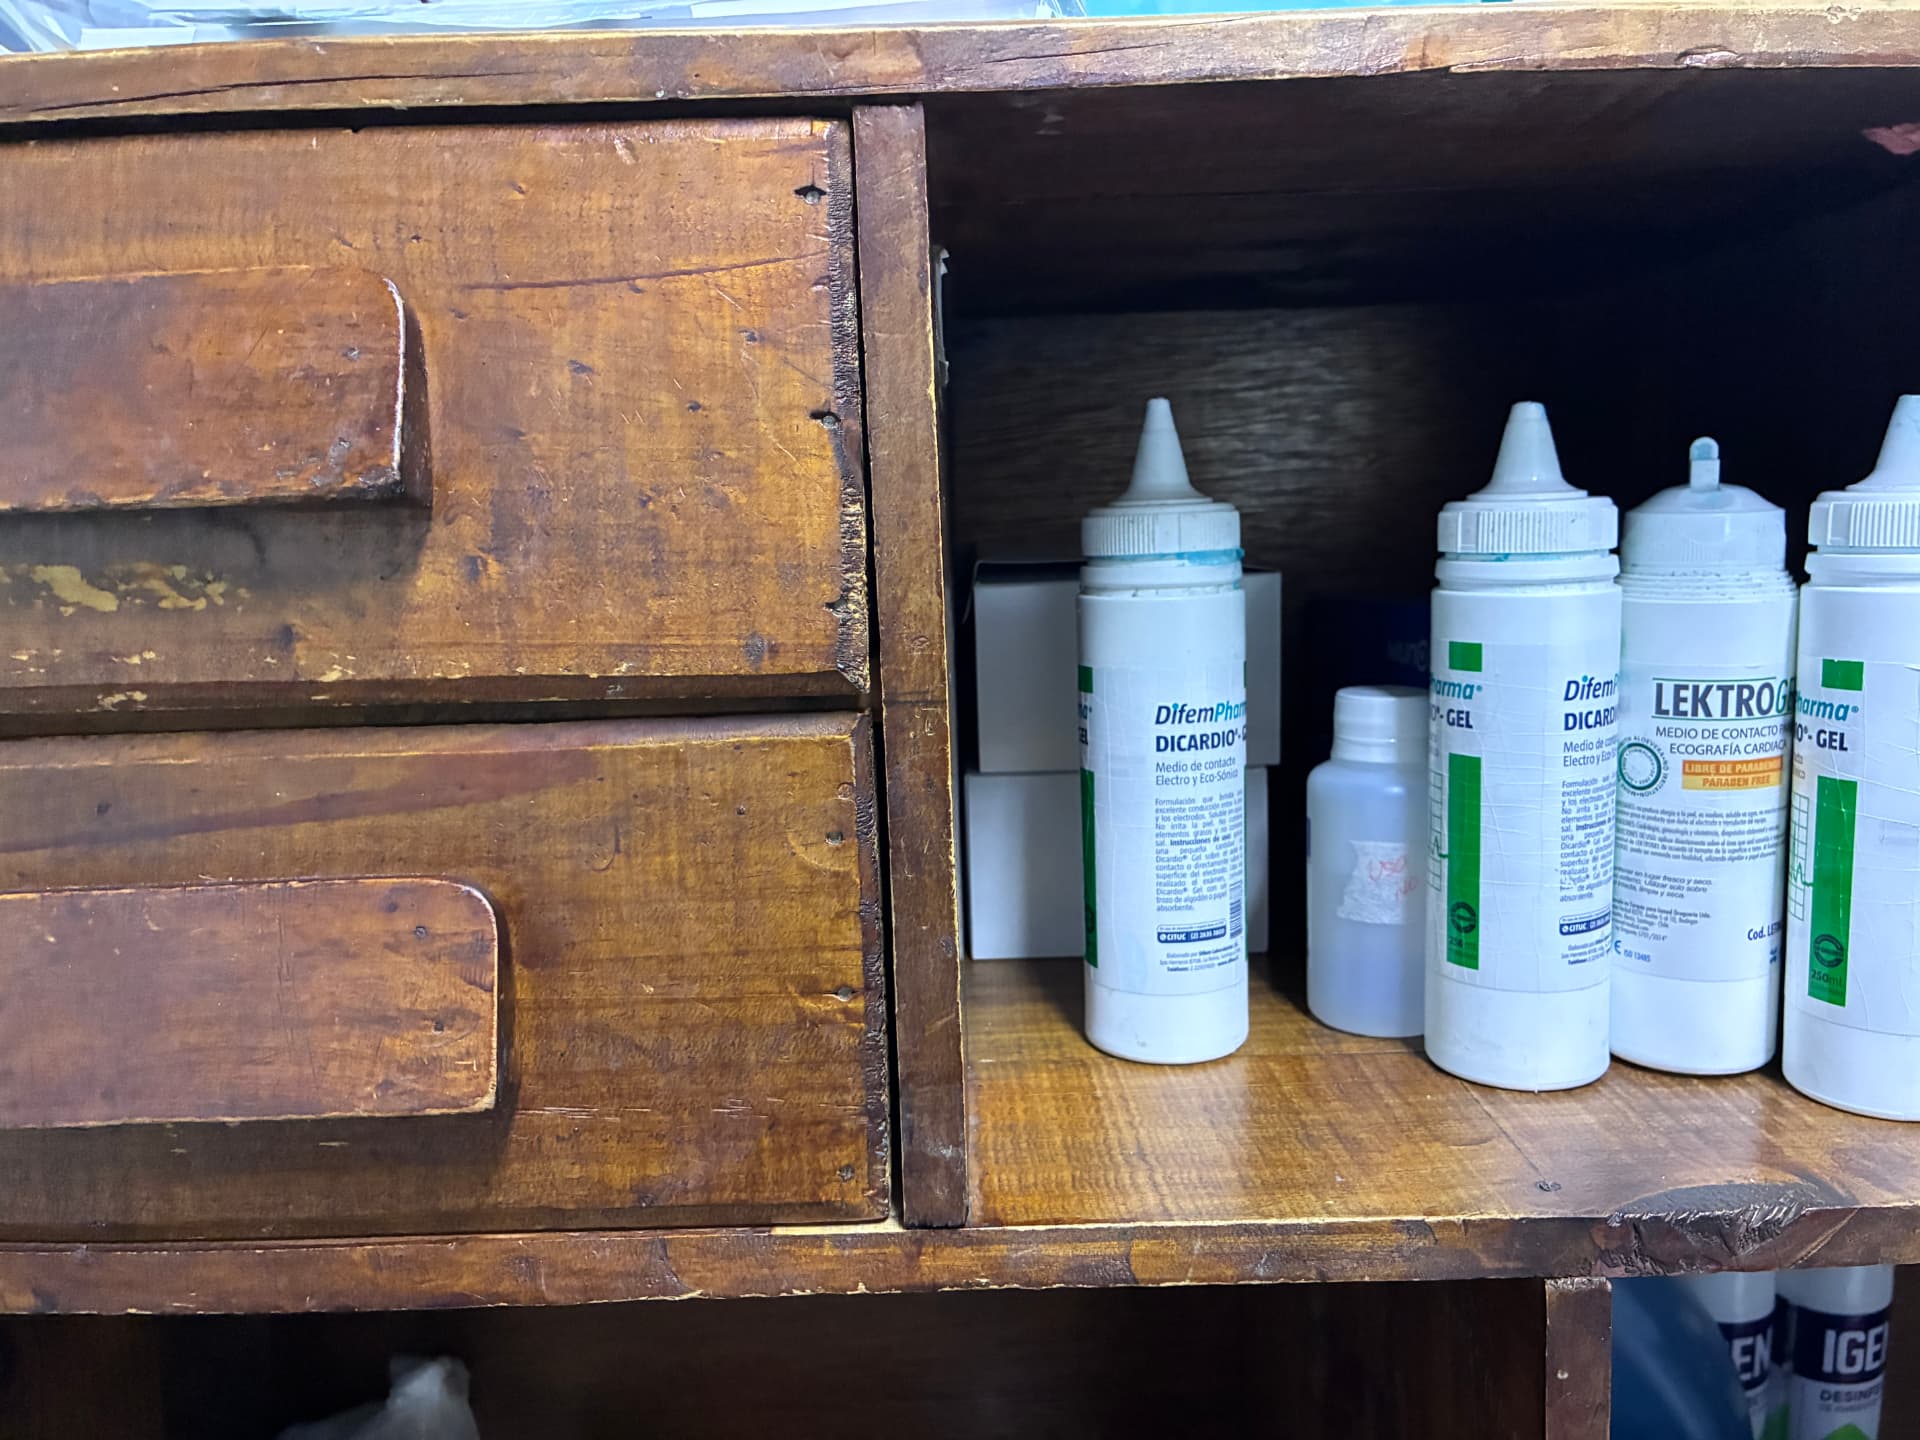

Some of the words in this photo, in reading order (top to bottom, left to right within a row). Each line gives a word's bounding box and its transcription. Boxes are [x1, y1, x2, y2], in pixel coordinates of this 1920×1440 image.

[1446, 708, 1473, 729] GEL
[1656, 726, 1697, 739] MEDIO
[1701, 728, 1719, 740] DE
[1721, 725, 1778, 739] CONTACTO
[1563, 740, 1594, 754] Medio
[1816, 729, 1848, 752] GEL
[1670, 742, 1740, 756] ECOGRAFÍA
[1155, 761, 1188, 773] Medio
[1190, 760, 1202, 771] de
[1563, 753, 1595, 767] Electro
[1155, 775, 1190, 786] Electro
[1747, 926, 1766, 941] Cod.
